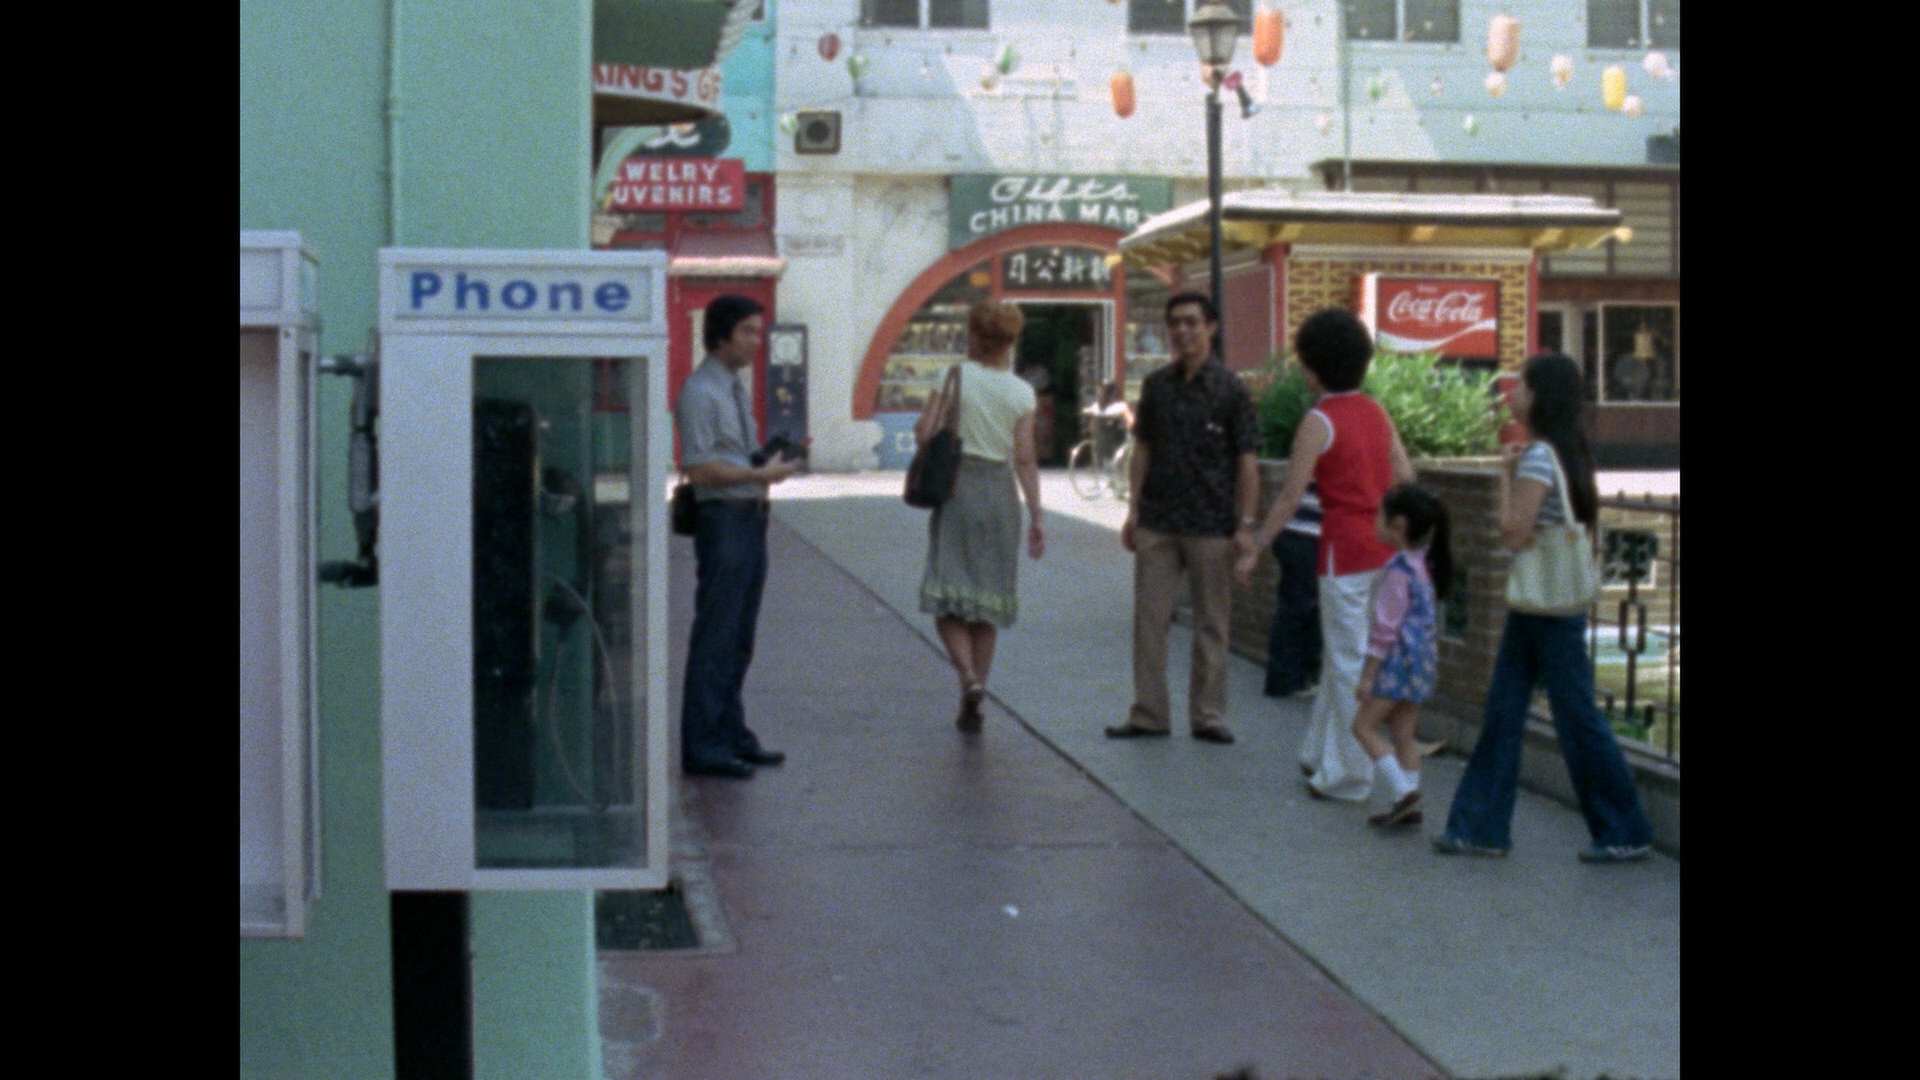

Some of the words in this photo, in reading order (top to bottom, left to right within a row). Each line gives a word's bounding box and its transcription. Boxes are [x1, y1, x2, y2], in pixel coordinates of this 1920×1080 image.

[991, 177, 1138, 203] Gifts
[970, 203, 1065, 233] CHINA
[410, 271, 632, 313] Phone
